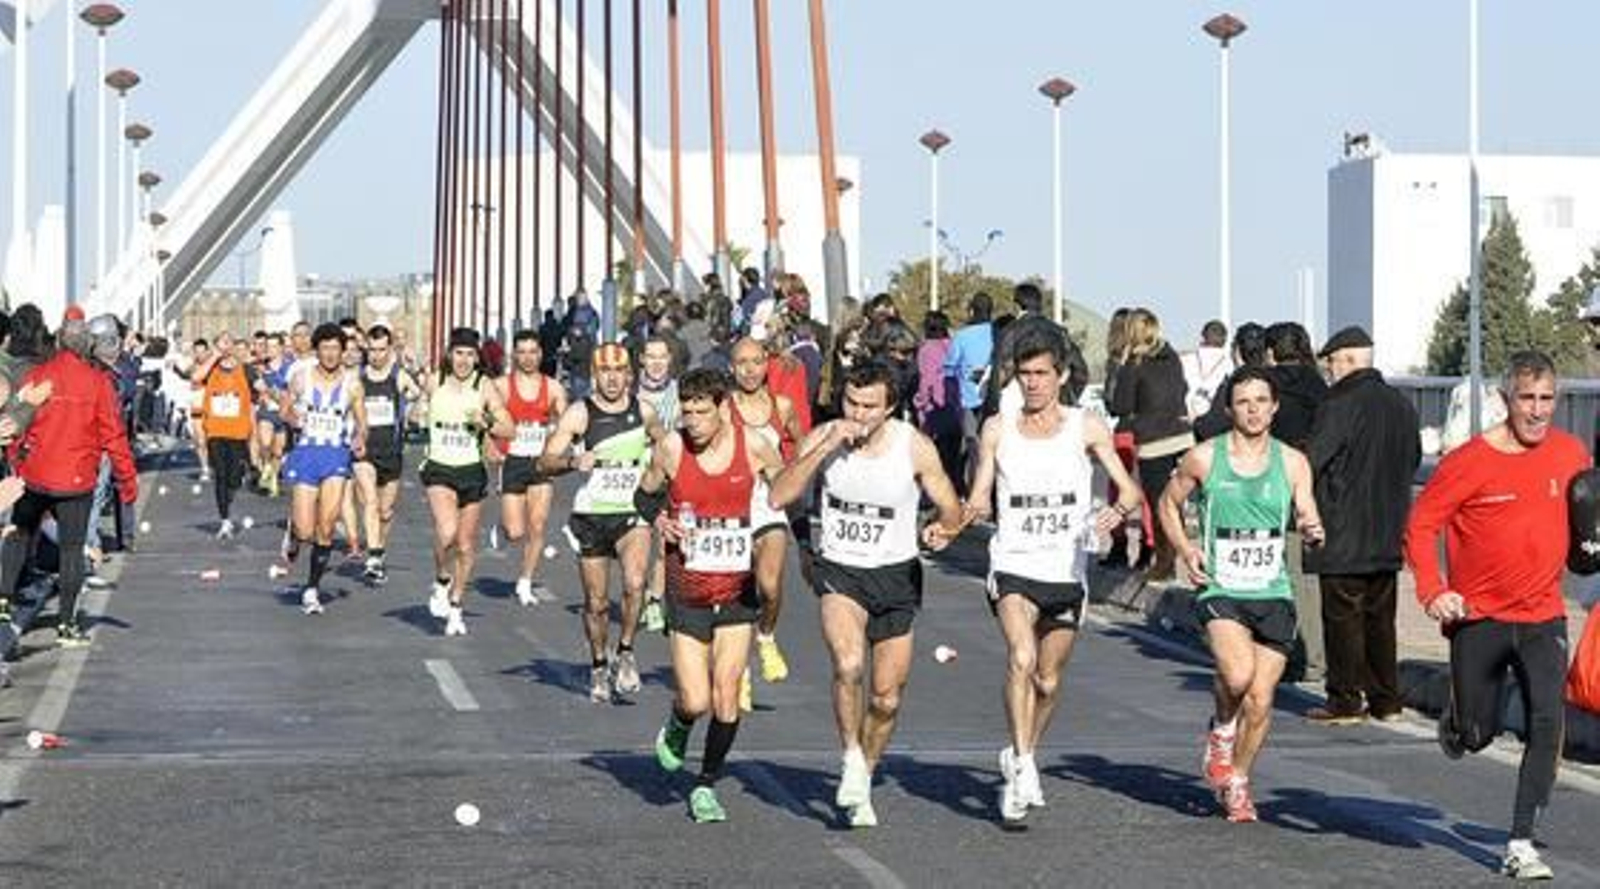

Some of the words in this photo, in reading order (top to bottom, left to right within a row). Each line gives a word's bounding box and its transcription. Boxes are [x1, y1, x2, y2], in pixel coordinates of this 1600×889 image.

[835, 519, 885, 544] 3037
[1021, 512, 1069, 534] 4734
[700, 536, 746, 557] 4913
[1228, 544, 1275, 568] 4735
